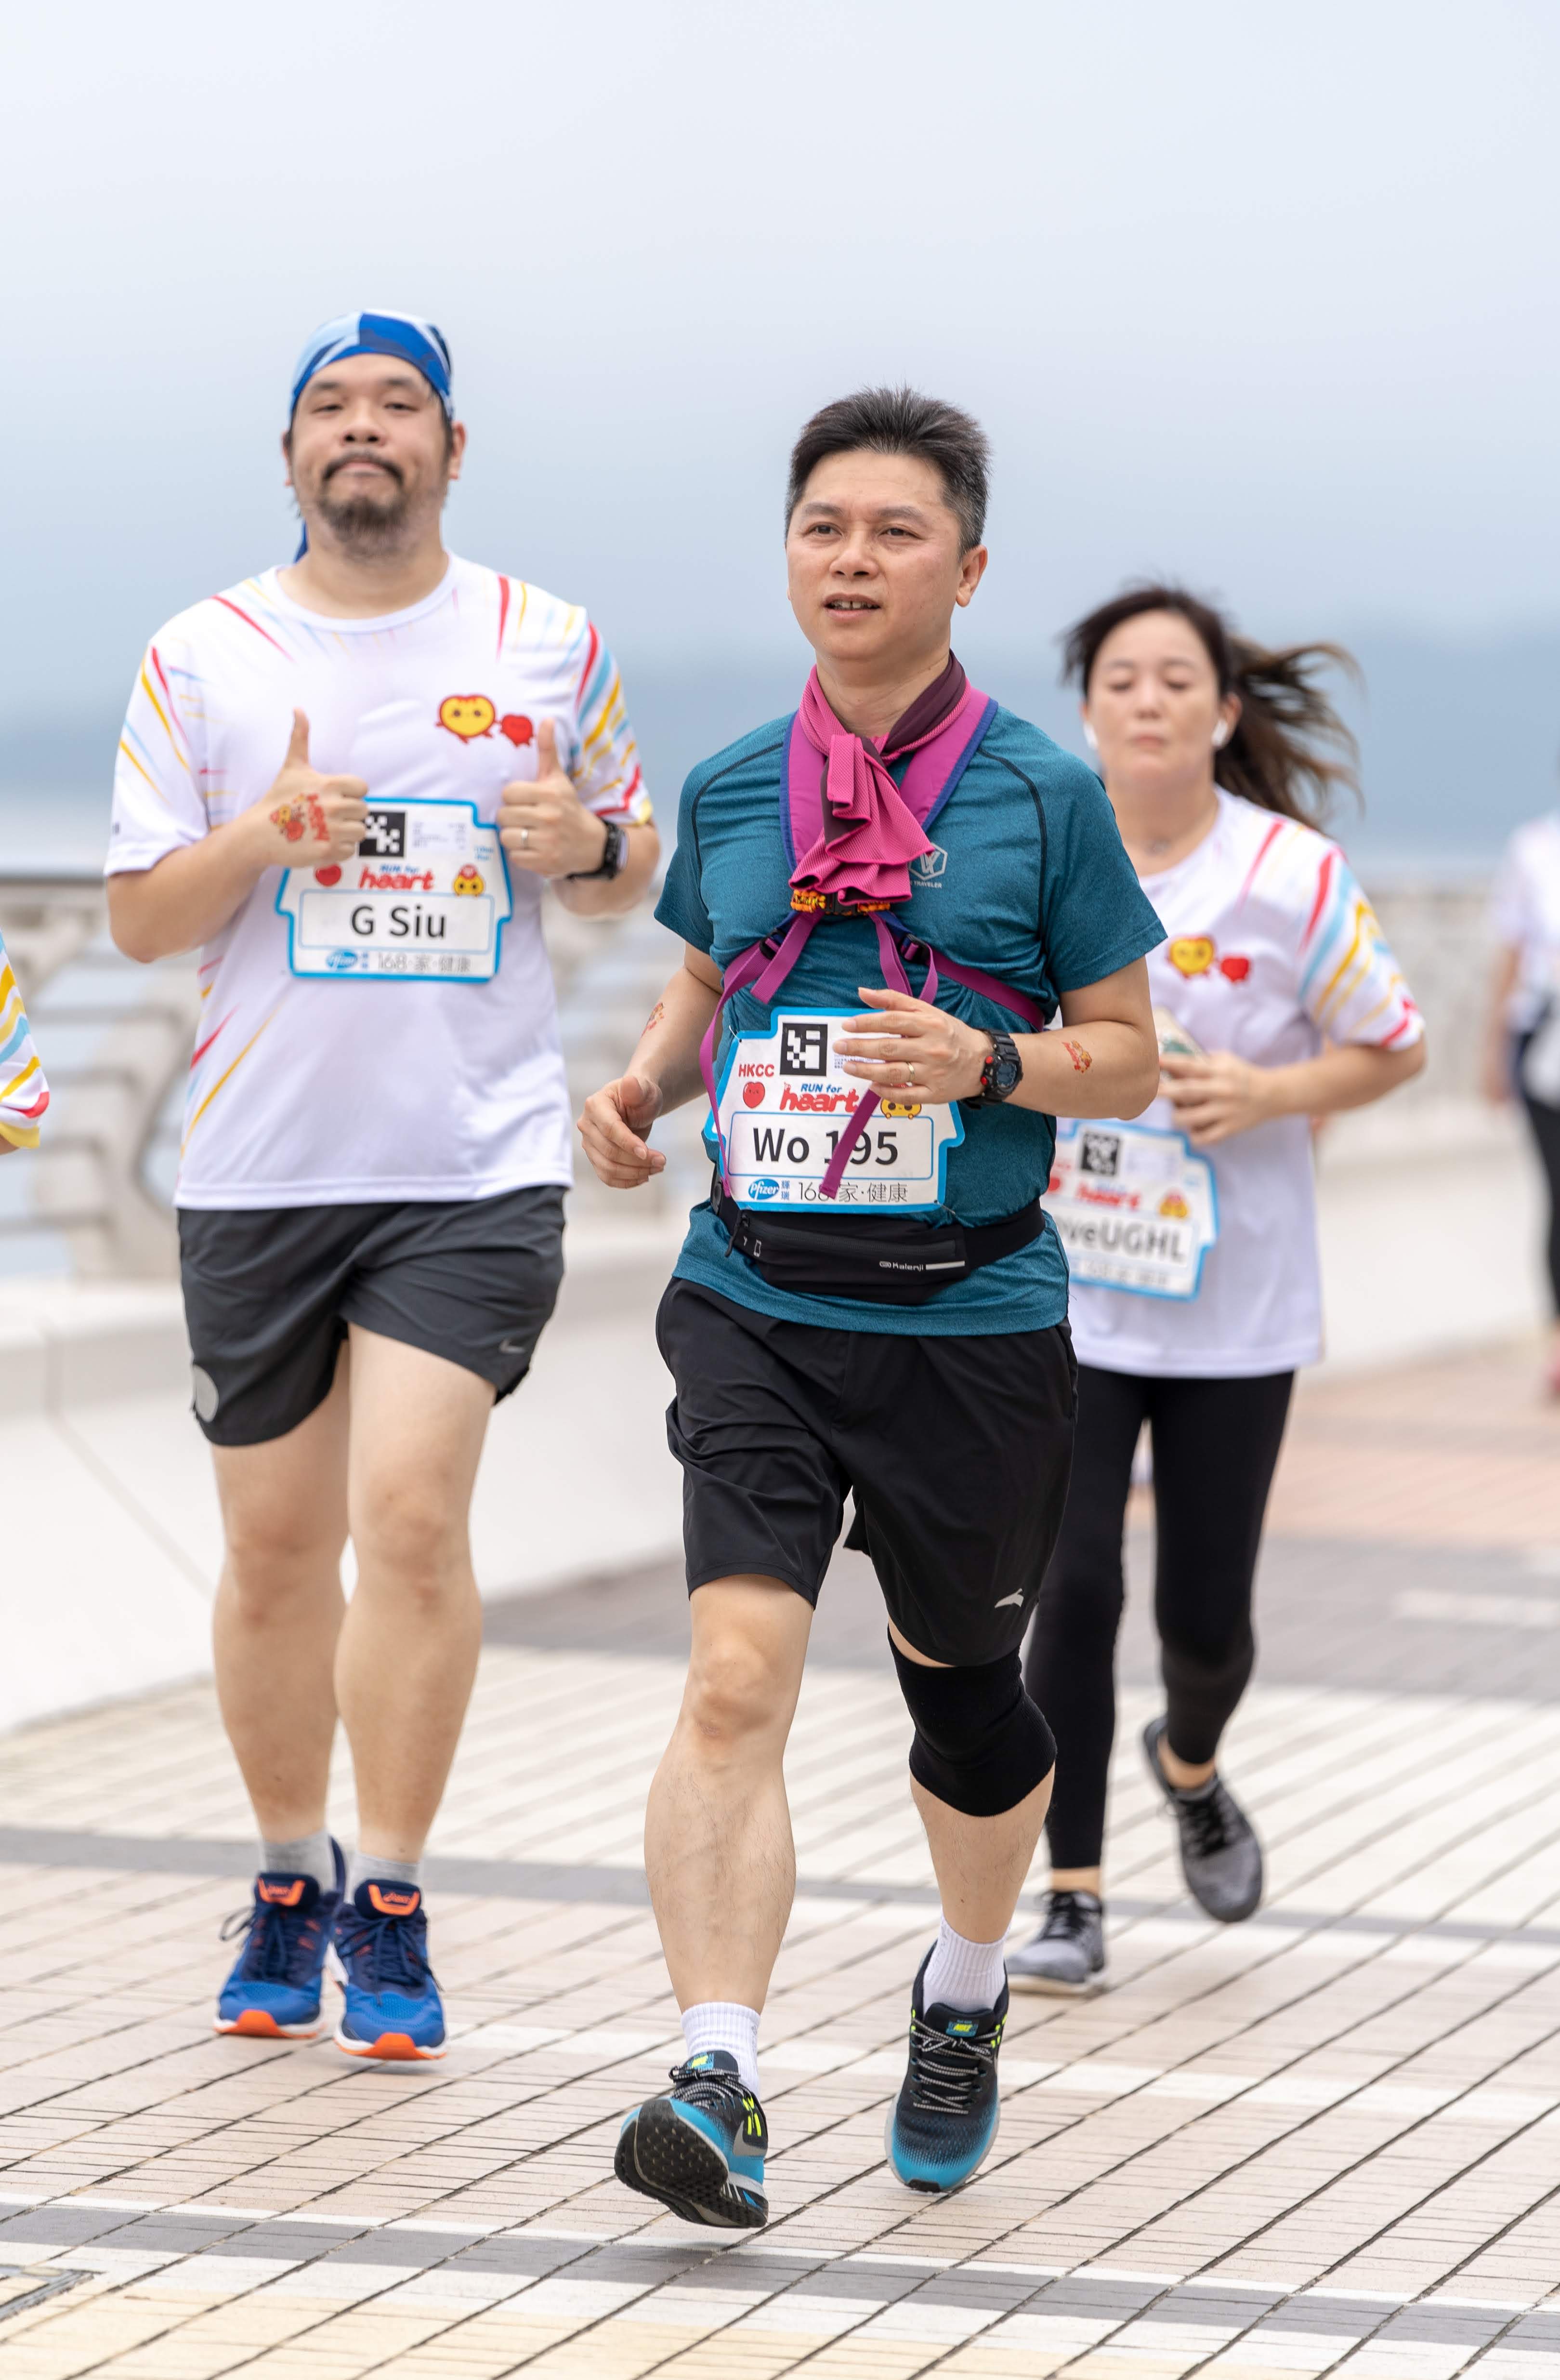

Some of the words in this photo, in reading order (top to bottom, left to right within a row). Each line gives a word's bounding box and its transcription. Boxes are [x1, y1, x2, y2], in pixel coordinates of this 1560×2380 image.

[359, 865, 433, 890] heart
[351, 905, 374, 935] G
[389, 905, 446, 938] Siu
[738, 1063, 774, 1078] HKCC
[779, 1082, 860, 1113] heart
[800, 1083, 823, 1093] RUN
[826, 1083, 842, 1093] for
[753, 1127, 810, 1163] Wo
[824, 1130, 898, 1165] 195
[749, 1179, 779, 1201] Pfizer
[892, 1262, 923, 1272] Kalenji
